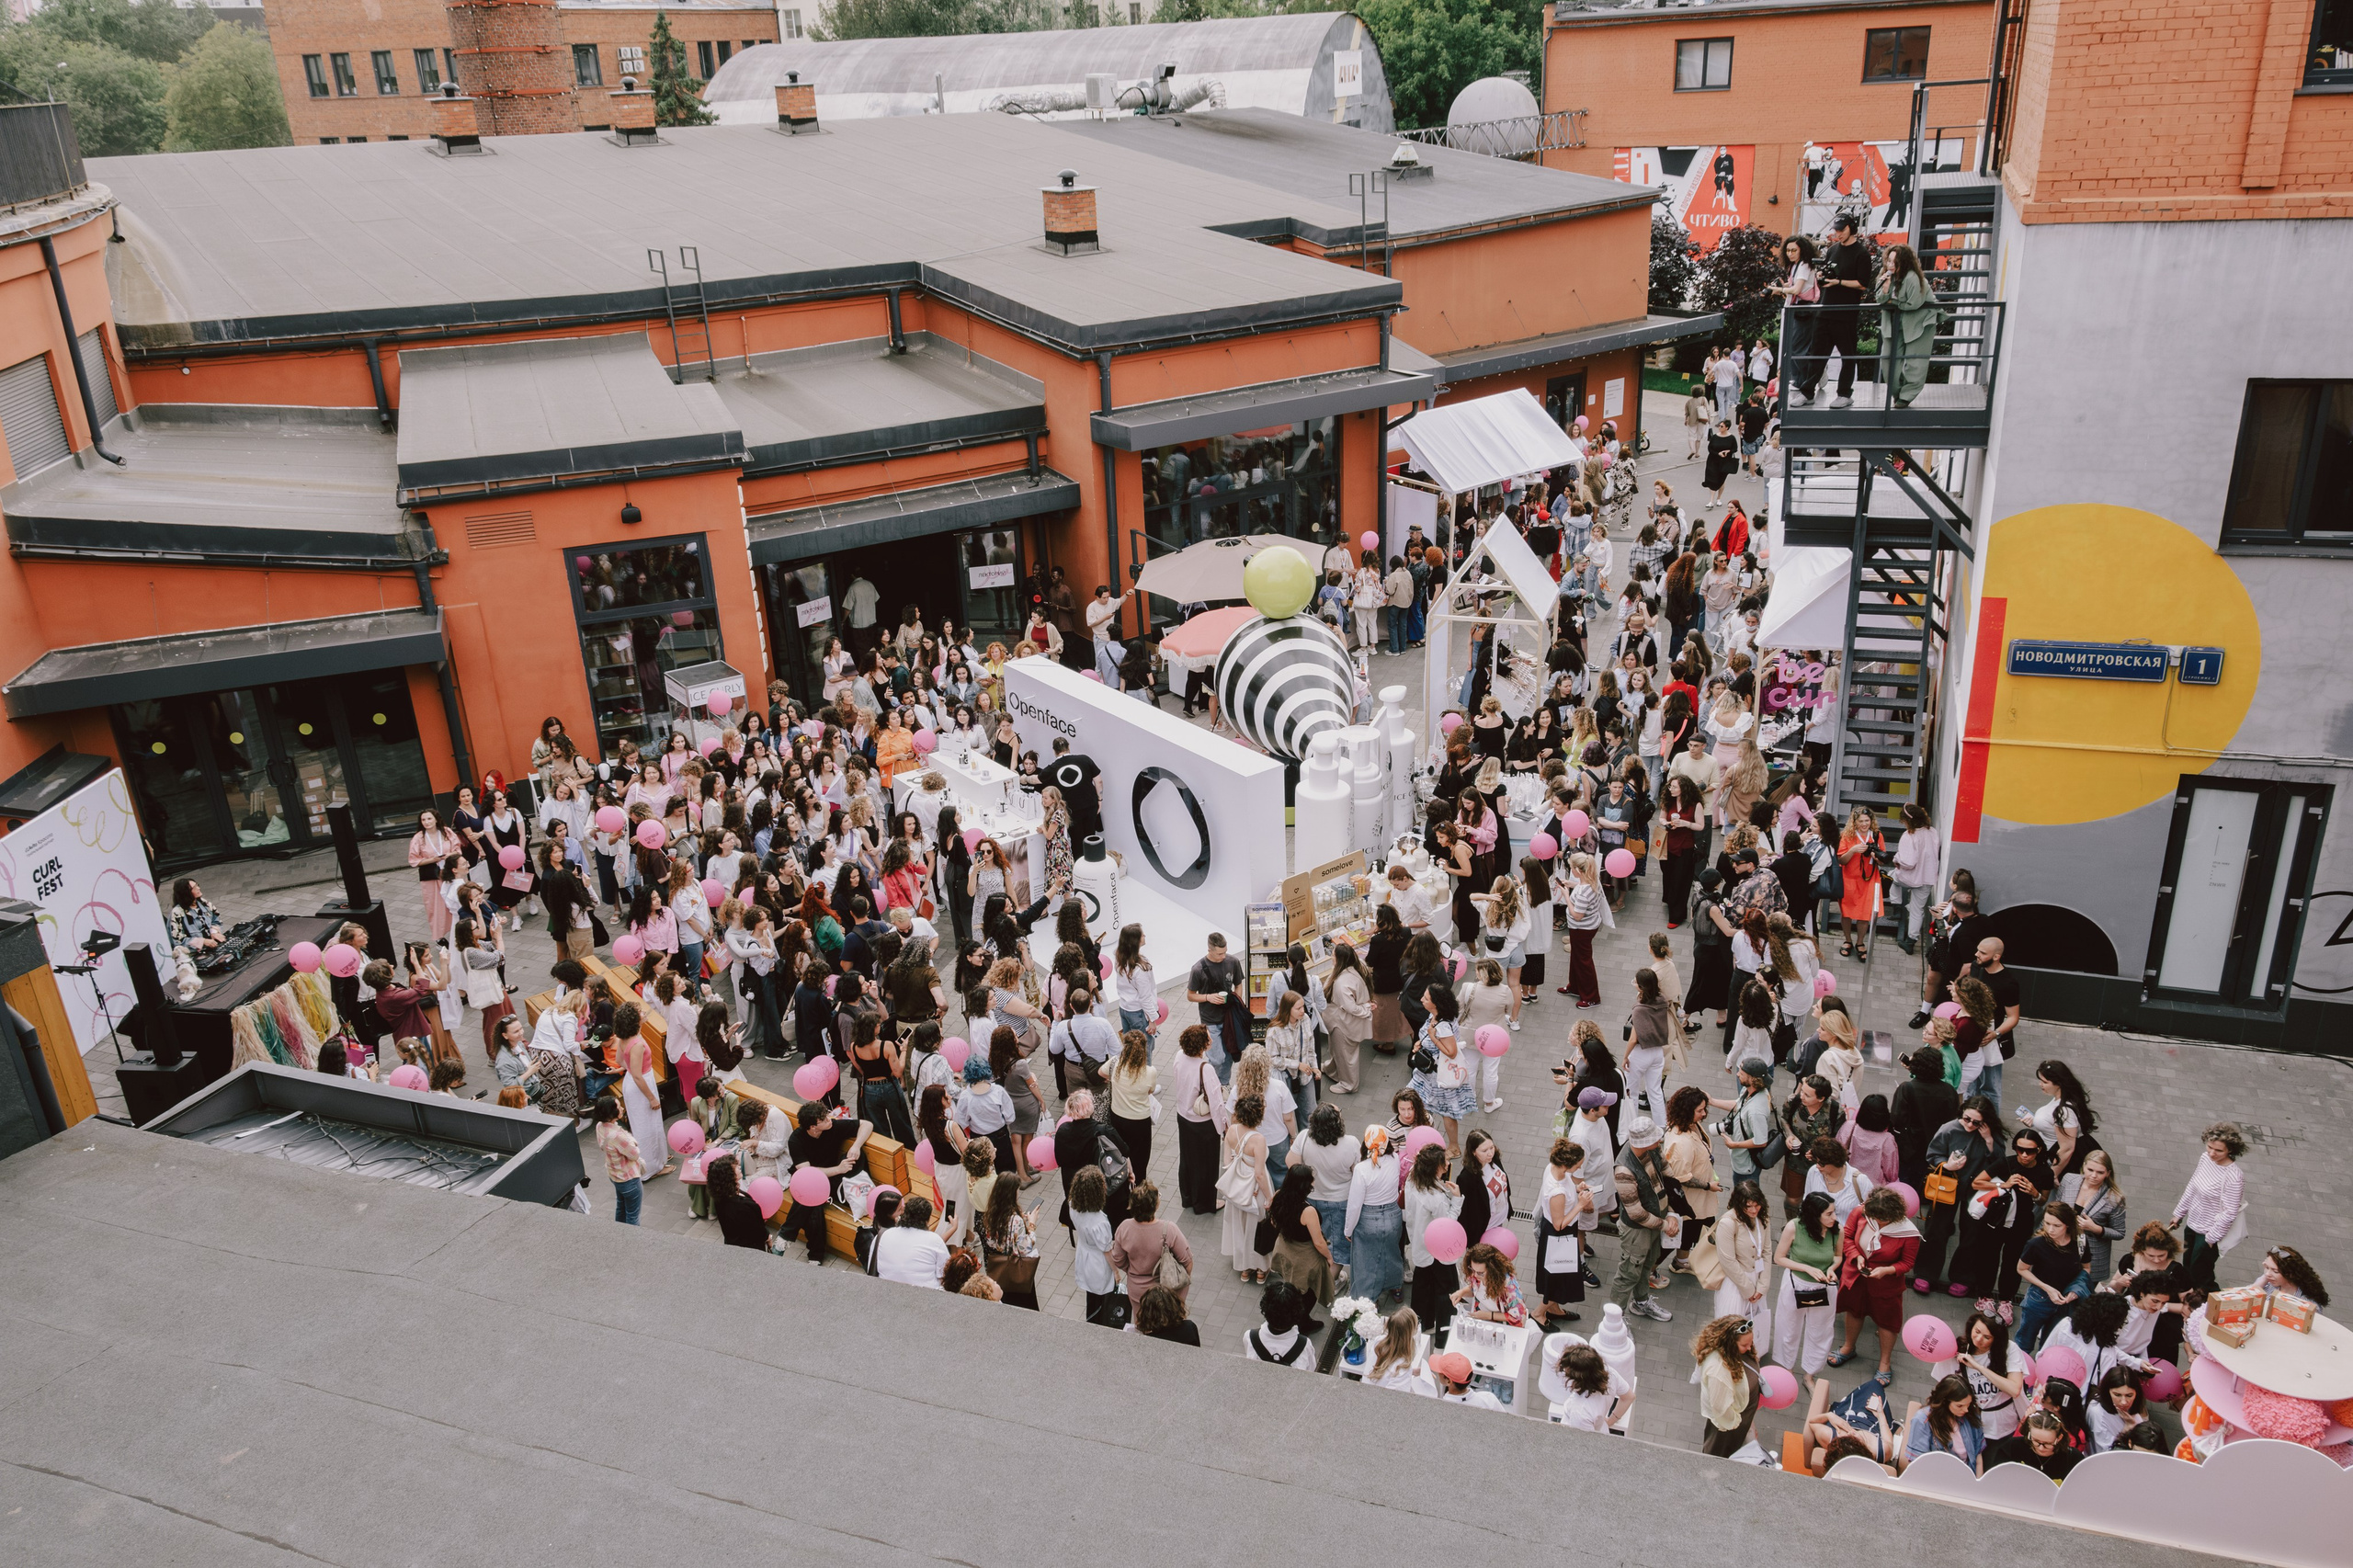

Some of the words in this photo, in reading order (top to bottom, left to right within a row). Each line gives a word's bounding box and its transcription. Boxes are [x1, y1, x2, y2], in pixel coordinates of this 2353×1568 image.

[1689, 214, 1741, 228] ЧТИВО
[1779, 653, 1826, 683] be
[2015, 650, 2162, 668] НОВОДМИТРОВСКАЯ
[2198, 658, 2207, 675] 1
[690, 689, 707, 701] ICE
[1008, 691, 1077, 738] Openface
[32, 856, 63, 883] CURL
[1321, 858, 1354, 877] somelove
[37, 872, 63, 901] FEST
[1109, 871, 1120, 930] Openface
[1919, 1324, 1936, 1351] КУДРЯВЫЙ
[1927, 1337, 1938, 1354] МЕТОД
